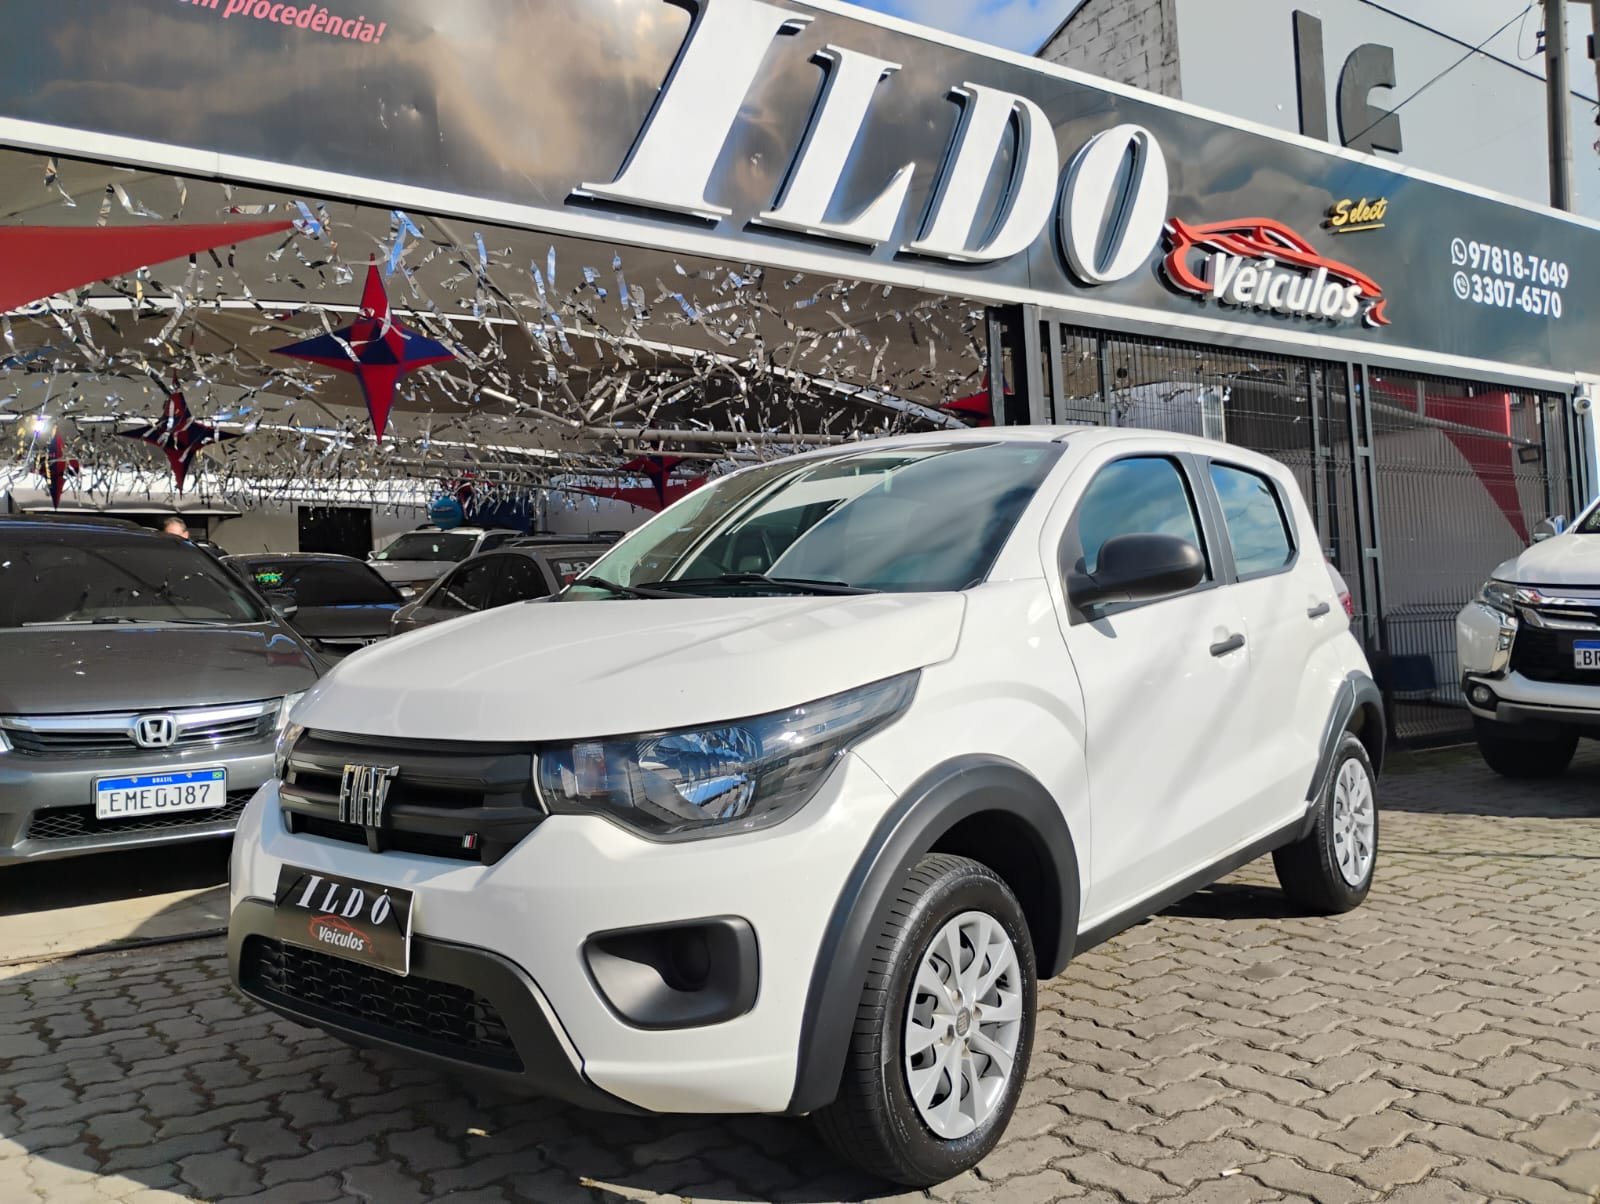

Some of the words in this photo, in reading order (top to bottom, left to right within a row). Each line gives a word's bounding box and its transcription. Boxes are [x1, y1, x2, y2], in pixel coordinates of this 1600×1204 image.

[223, 0, 387, 44] procedência!
[569, 0, 1168, 284] ILDO
[1331, 197, 1388, 226] Select
[1468, 240, 1569, 289] 97818-7649
[1471, 274, 1562, 319] 3307-6570
[338, 764, 399, 827] FIAT
[296, 874, 391, 925] ILDO
